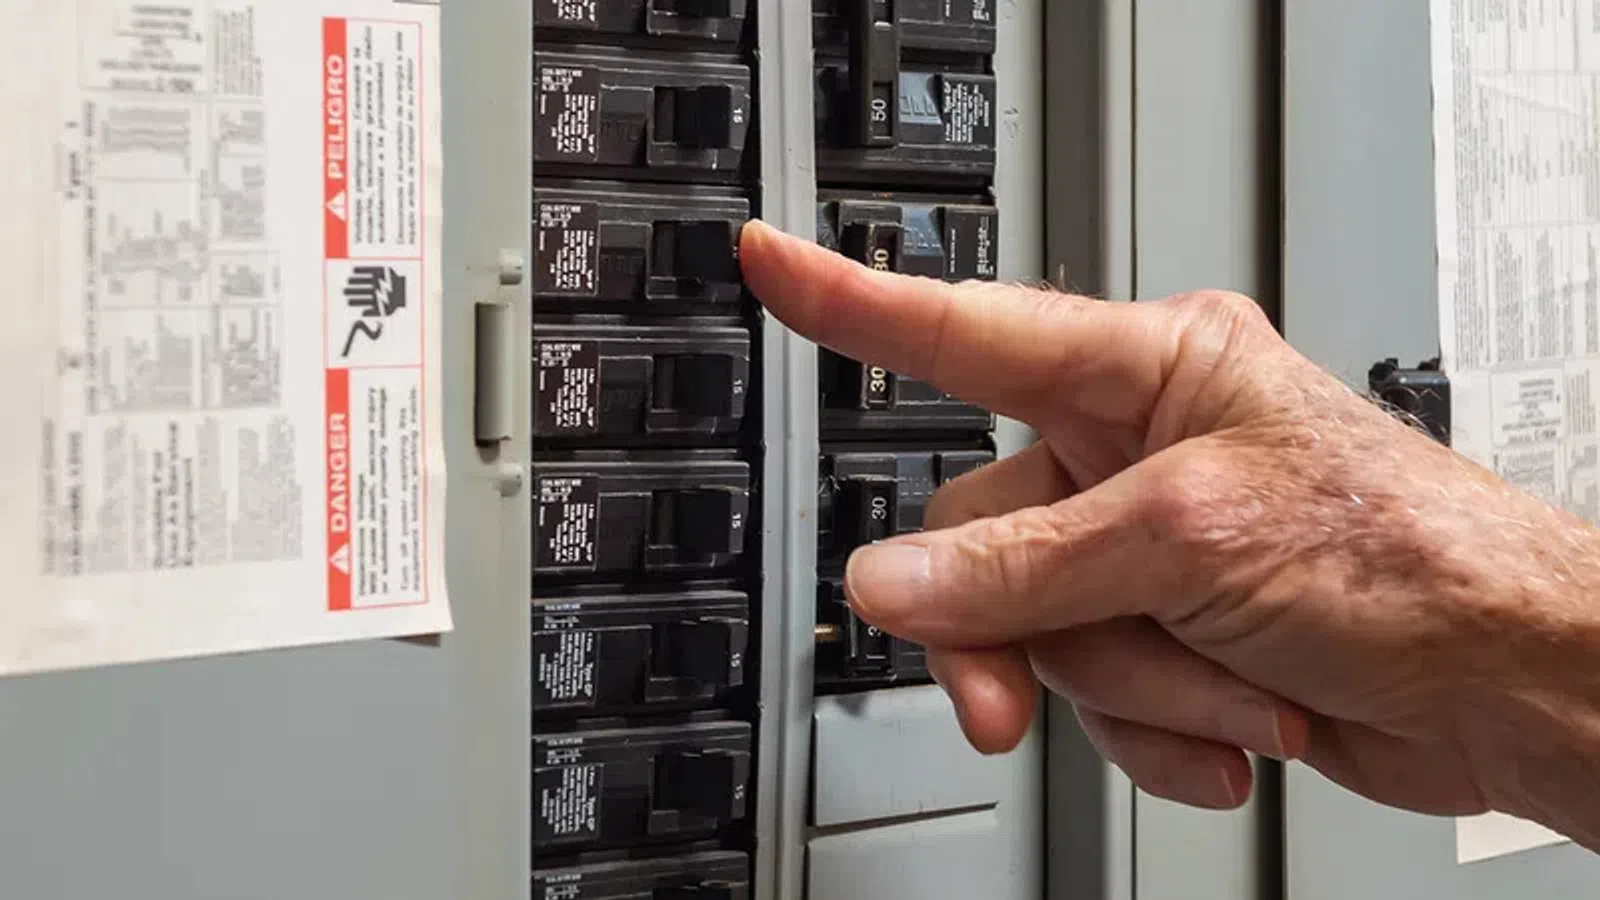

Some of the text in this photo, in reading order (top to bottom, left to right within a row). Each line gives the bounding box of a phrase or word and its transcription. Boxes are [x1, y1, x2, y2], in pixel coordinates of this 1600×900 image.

[326, 54, 345, 180] PELIGRO
[732, 107, 744, 123] 15
[871, 98, 886, 122] 50
[732, 379, 744, 394] 15
[871, 367, 886, 393] 30
[329, 412, 347, 534] DANGER
[871, 496, 887, 520] 30
[731, 513, 742, 529] 15
[868, 625, 882, 637] 3
[730, 652, 741, 667] 15
[734, 784, 745, 800] 15
